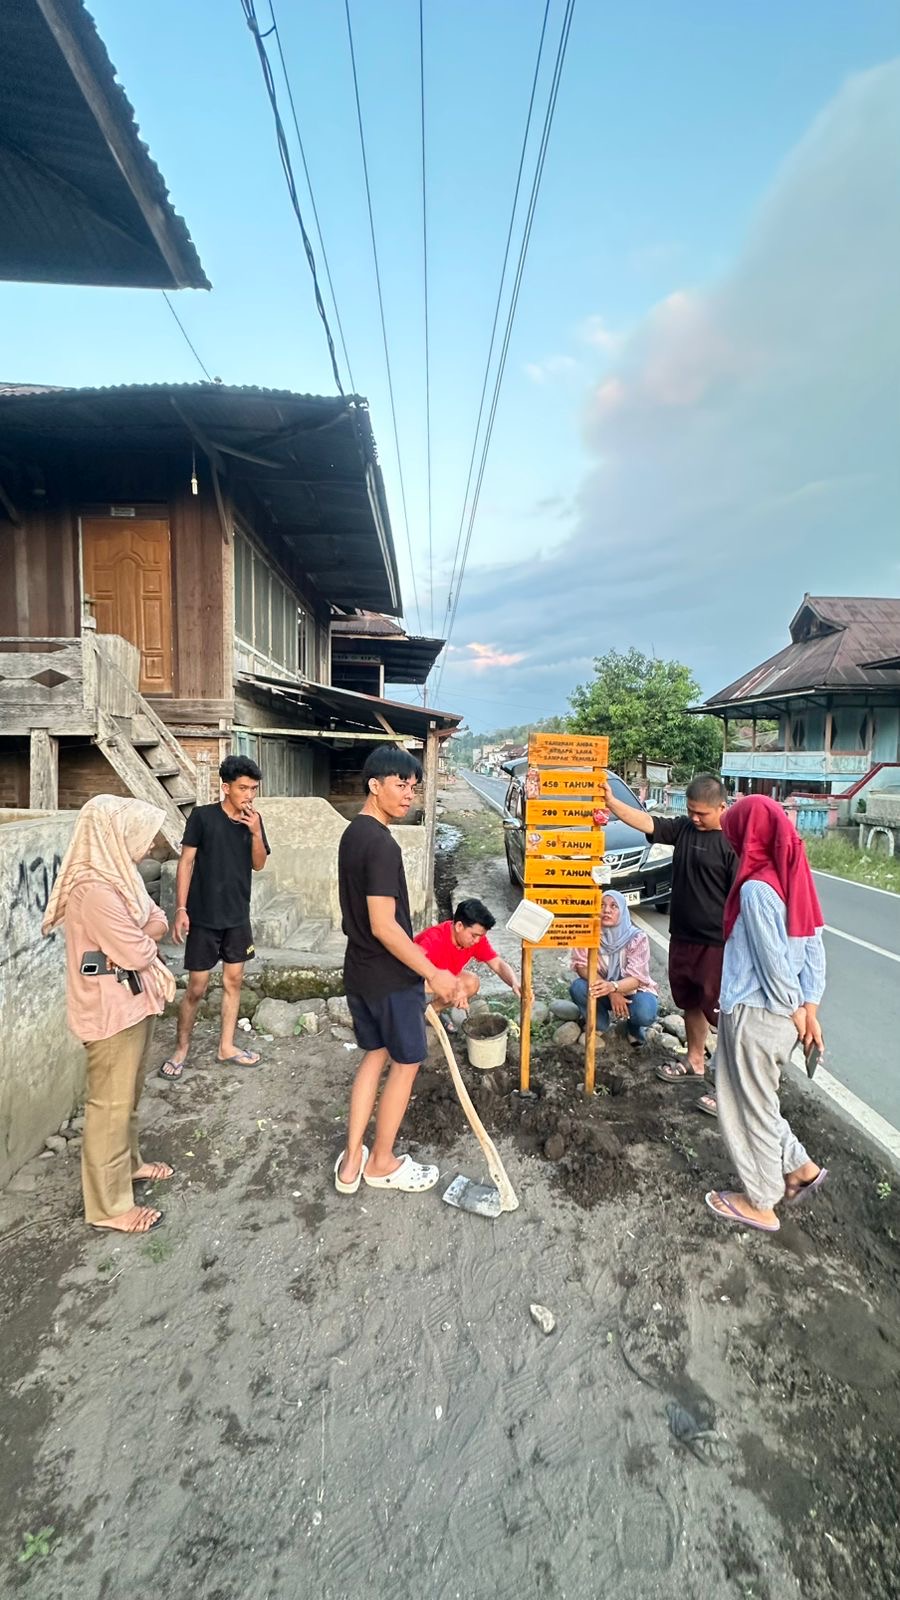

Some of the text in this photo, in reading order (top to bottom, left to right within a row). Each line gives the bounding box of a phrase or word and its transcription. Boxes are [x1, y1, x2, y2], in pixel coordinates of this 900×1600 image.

[564, 781, 594, 789] TAHUN
[561, 841, 592, 849] TAHUN
[561, 869, 592, 877] TAHUN
